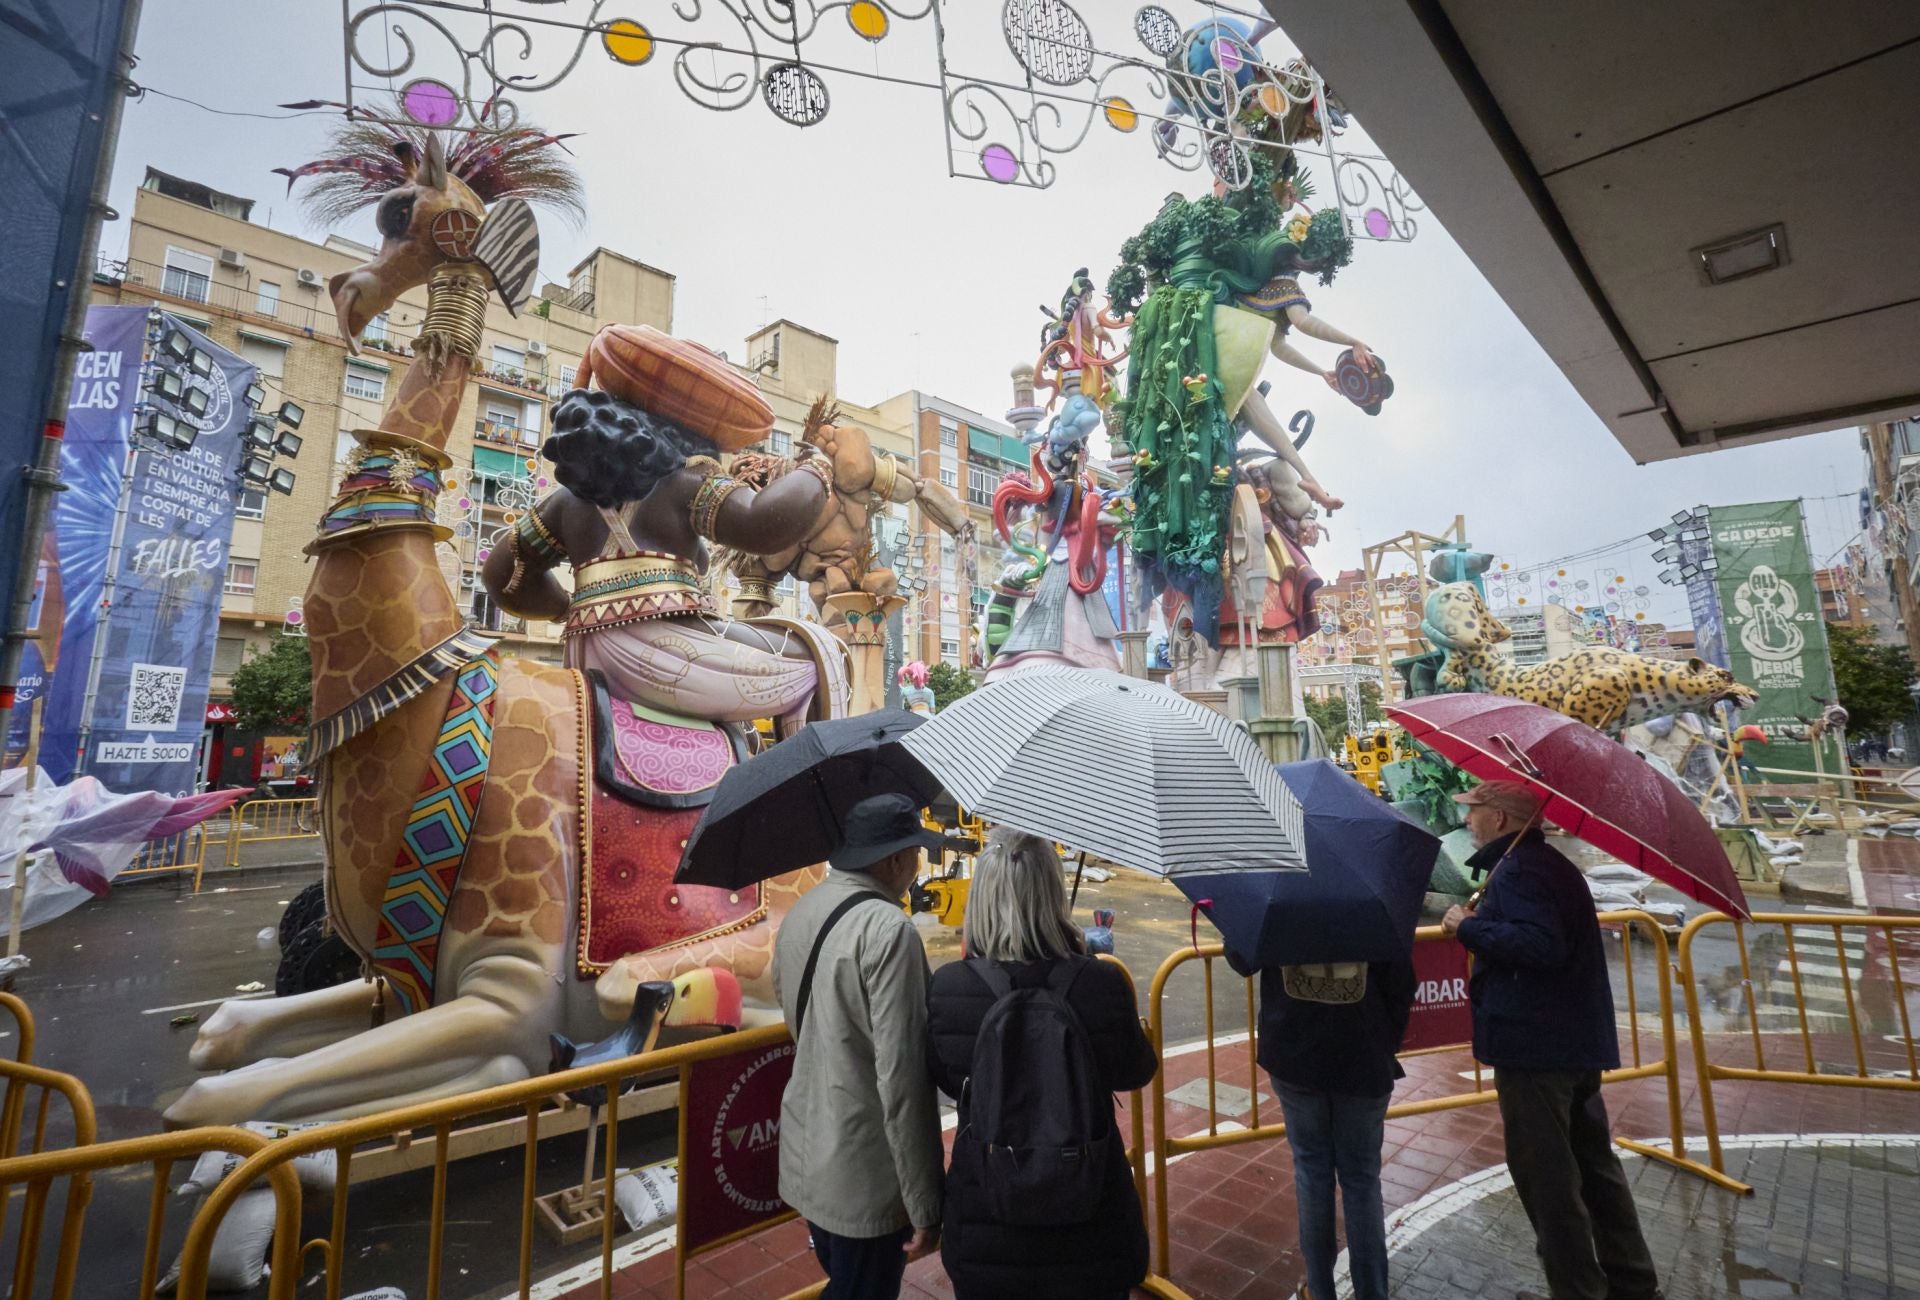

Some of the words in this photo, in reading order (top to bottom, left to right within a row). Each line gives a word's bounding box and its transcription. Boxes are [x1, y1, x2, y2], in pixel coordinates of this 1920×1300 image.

[75, 351, 122, 378] CEN
[69, 381, 120, 409] LAS
[172, 455, 225, 485] CULTURA
[205, 451, 222, 467] DE
[148, 462, 169, 478] EN
[172, 470, 230, 502] VALENCIA
[144, 478, 150, 490] I
[153, 481, 206, 509] SEMPRE
[207, 501, 223, 515] AL
[139, 511, 165, 529] LES
[142, 495, 194, 521] COSTAT
[195, 512, 212, 527] DE
[1717, 530, 1742, 542] CA
[1743, 525, 1794, 541] PEPE
[132, 538, 221, 578] FALLES
[1752, 574, 1776, 590] ALL
[1727, 616, 1744, 625] 19
[1795, 612, 1816, 621] 62
[1751, 656, 1804, 680] PEBRE
[104, 747, 148, 759] HAZTE
[152, 747, 189, 759] SOCIO
[712, 1082, 741, 1158] ARTISTAS
[714, 1163, 727, 1184] DE
[722, 1182, 782, 1211] ARTESANO
